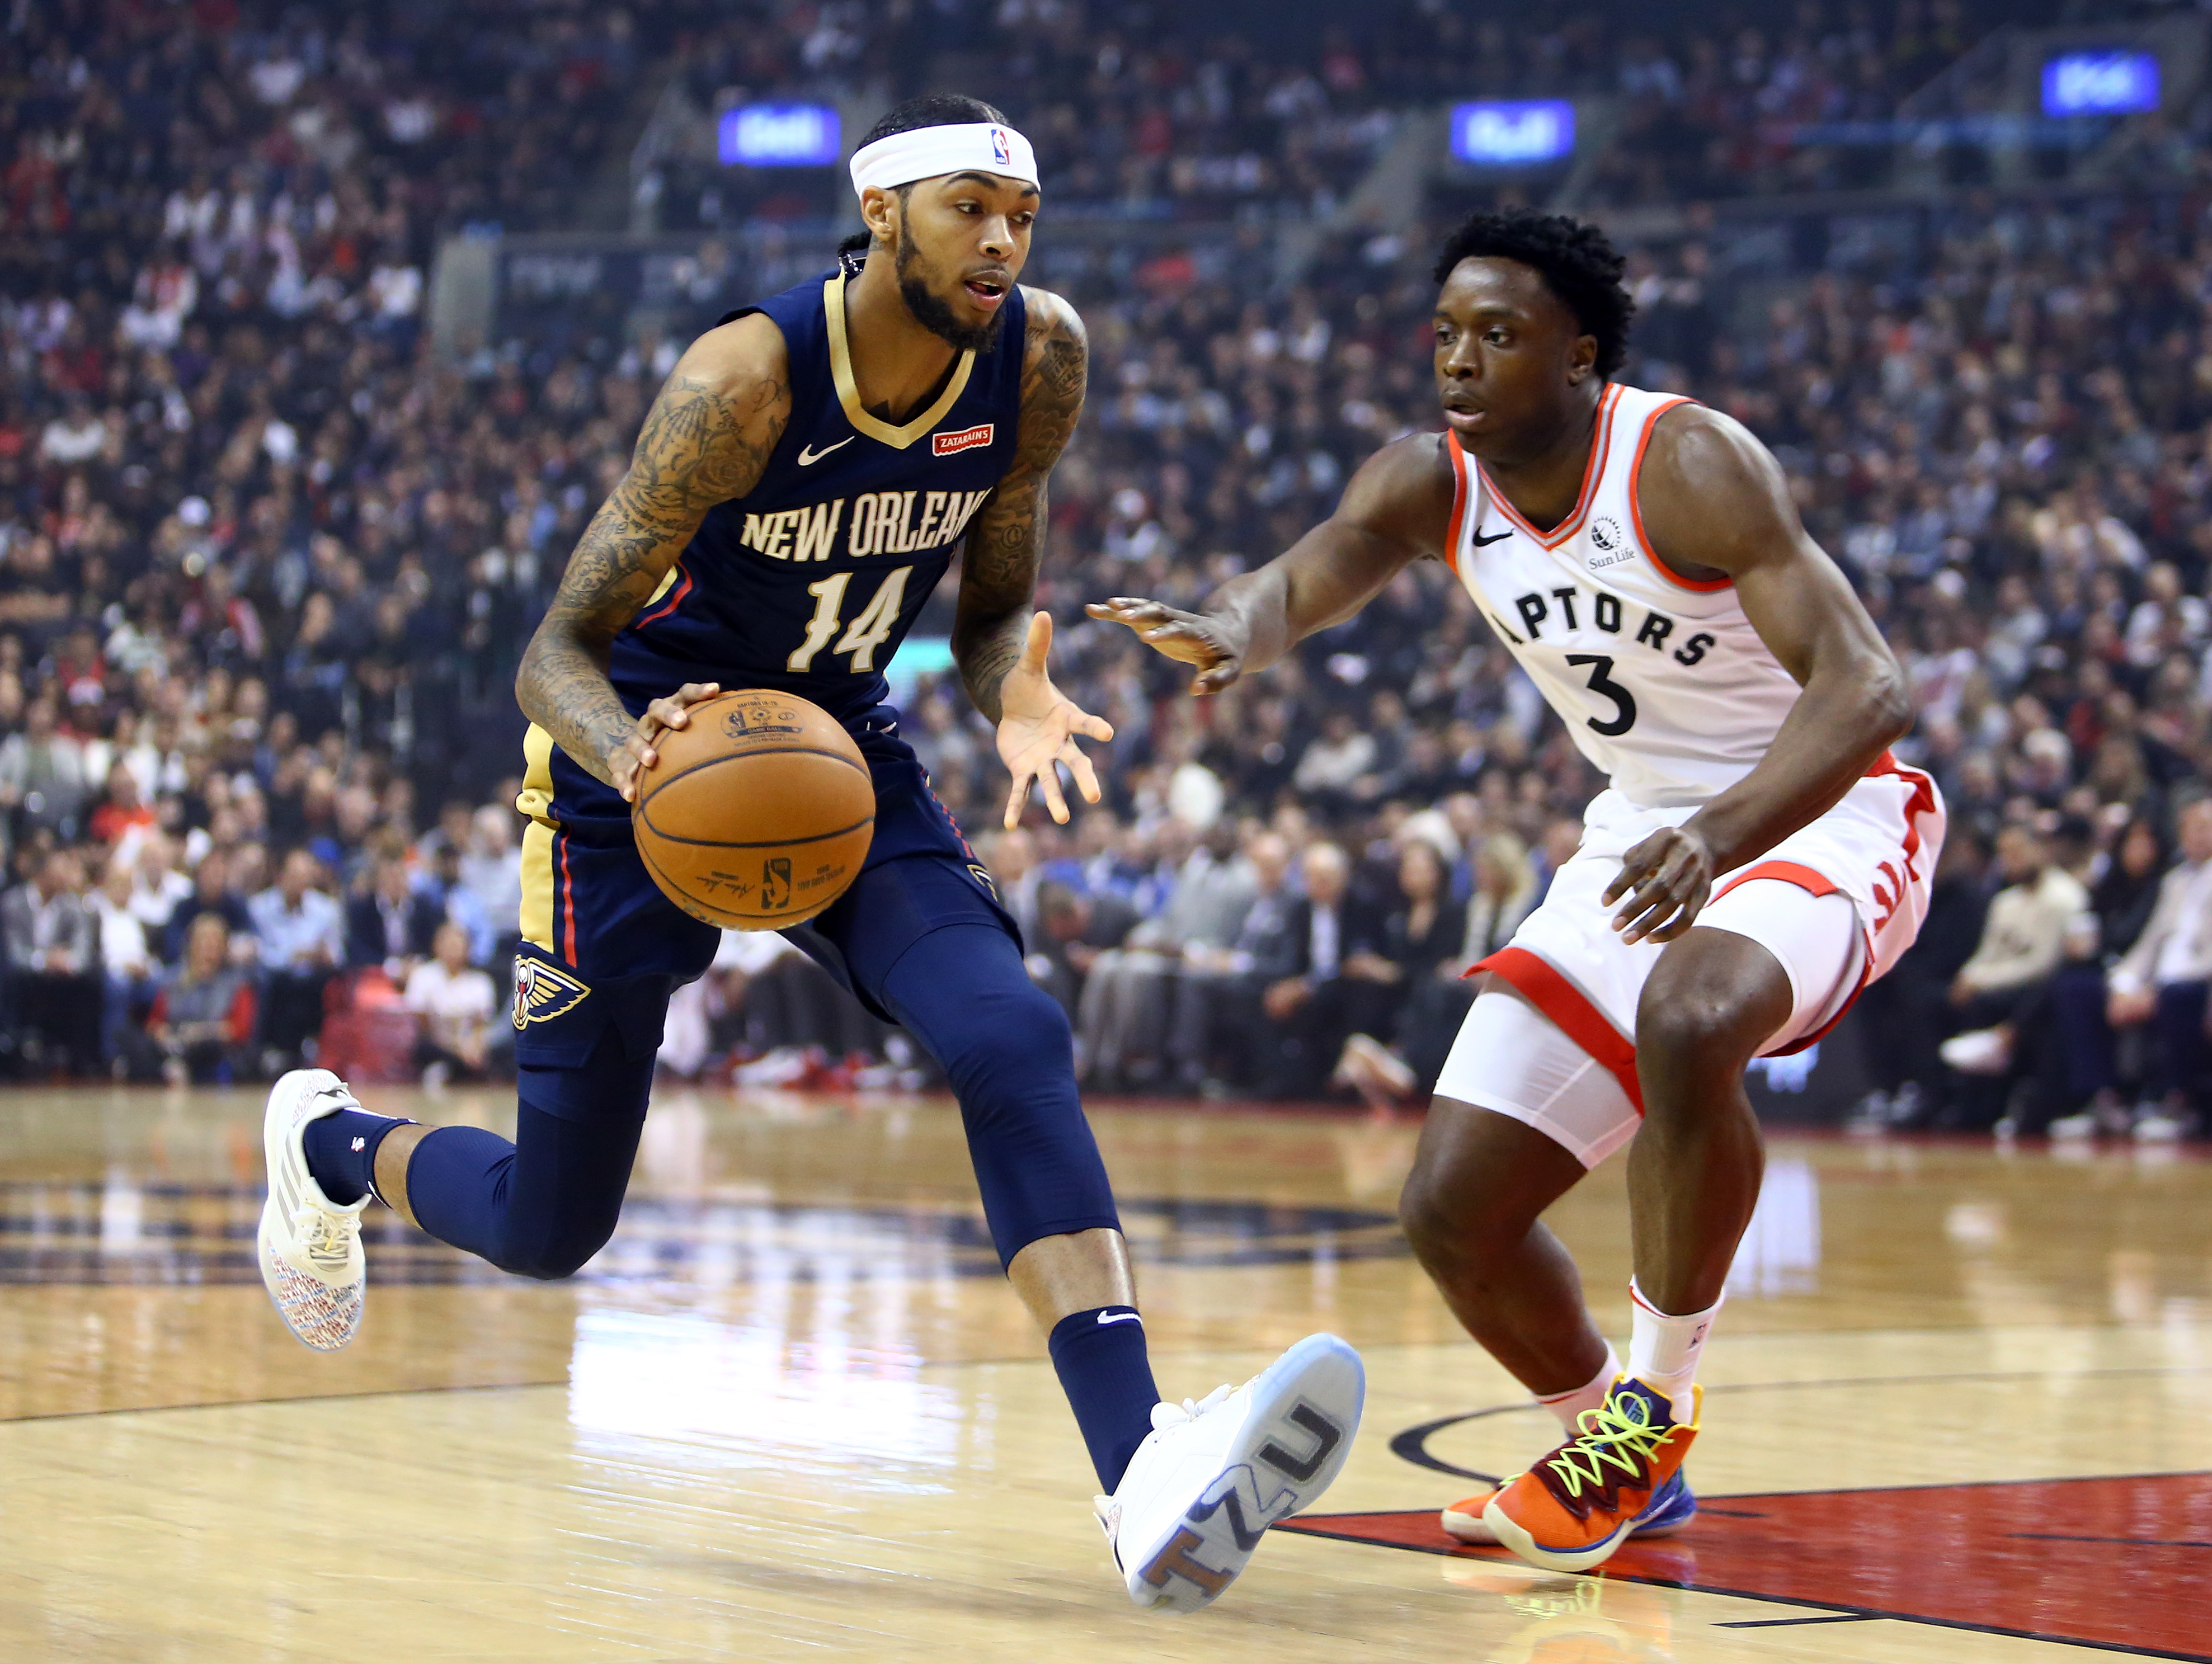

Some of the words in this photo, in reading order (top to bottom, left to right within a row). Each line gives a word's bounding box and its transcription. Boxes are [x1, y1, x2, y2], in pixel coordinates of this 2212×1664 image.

[740, 498, 844, 562] NEW
[848, 486, 994, 557] ORLEAN
[1589, 557, 1614, 569] Sun
[1614, 547, 1636, 562] Life
[787, 565, 914, 673] 14
[1564, 653, 1637, 737] 3
